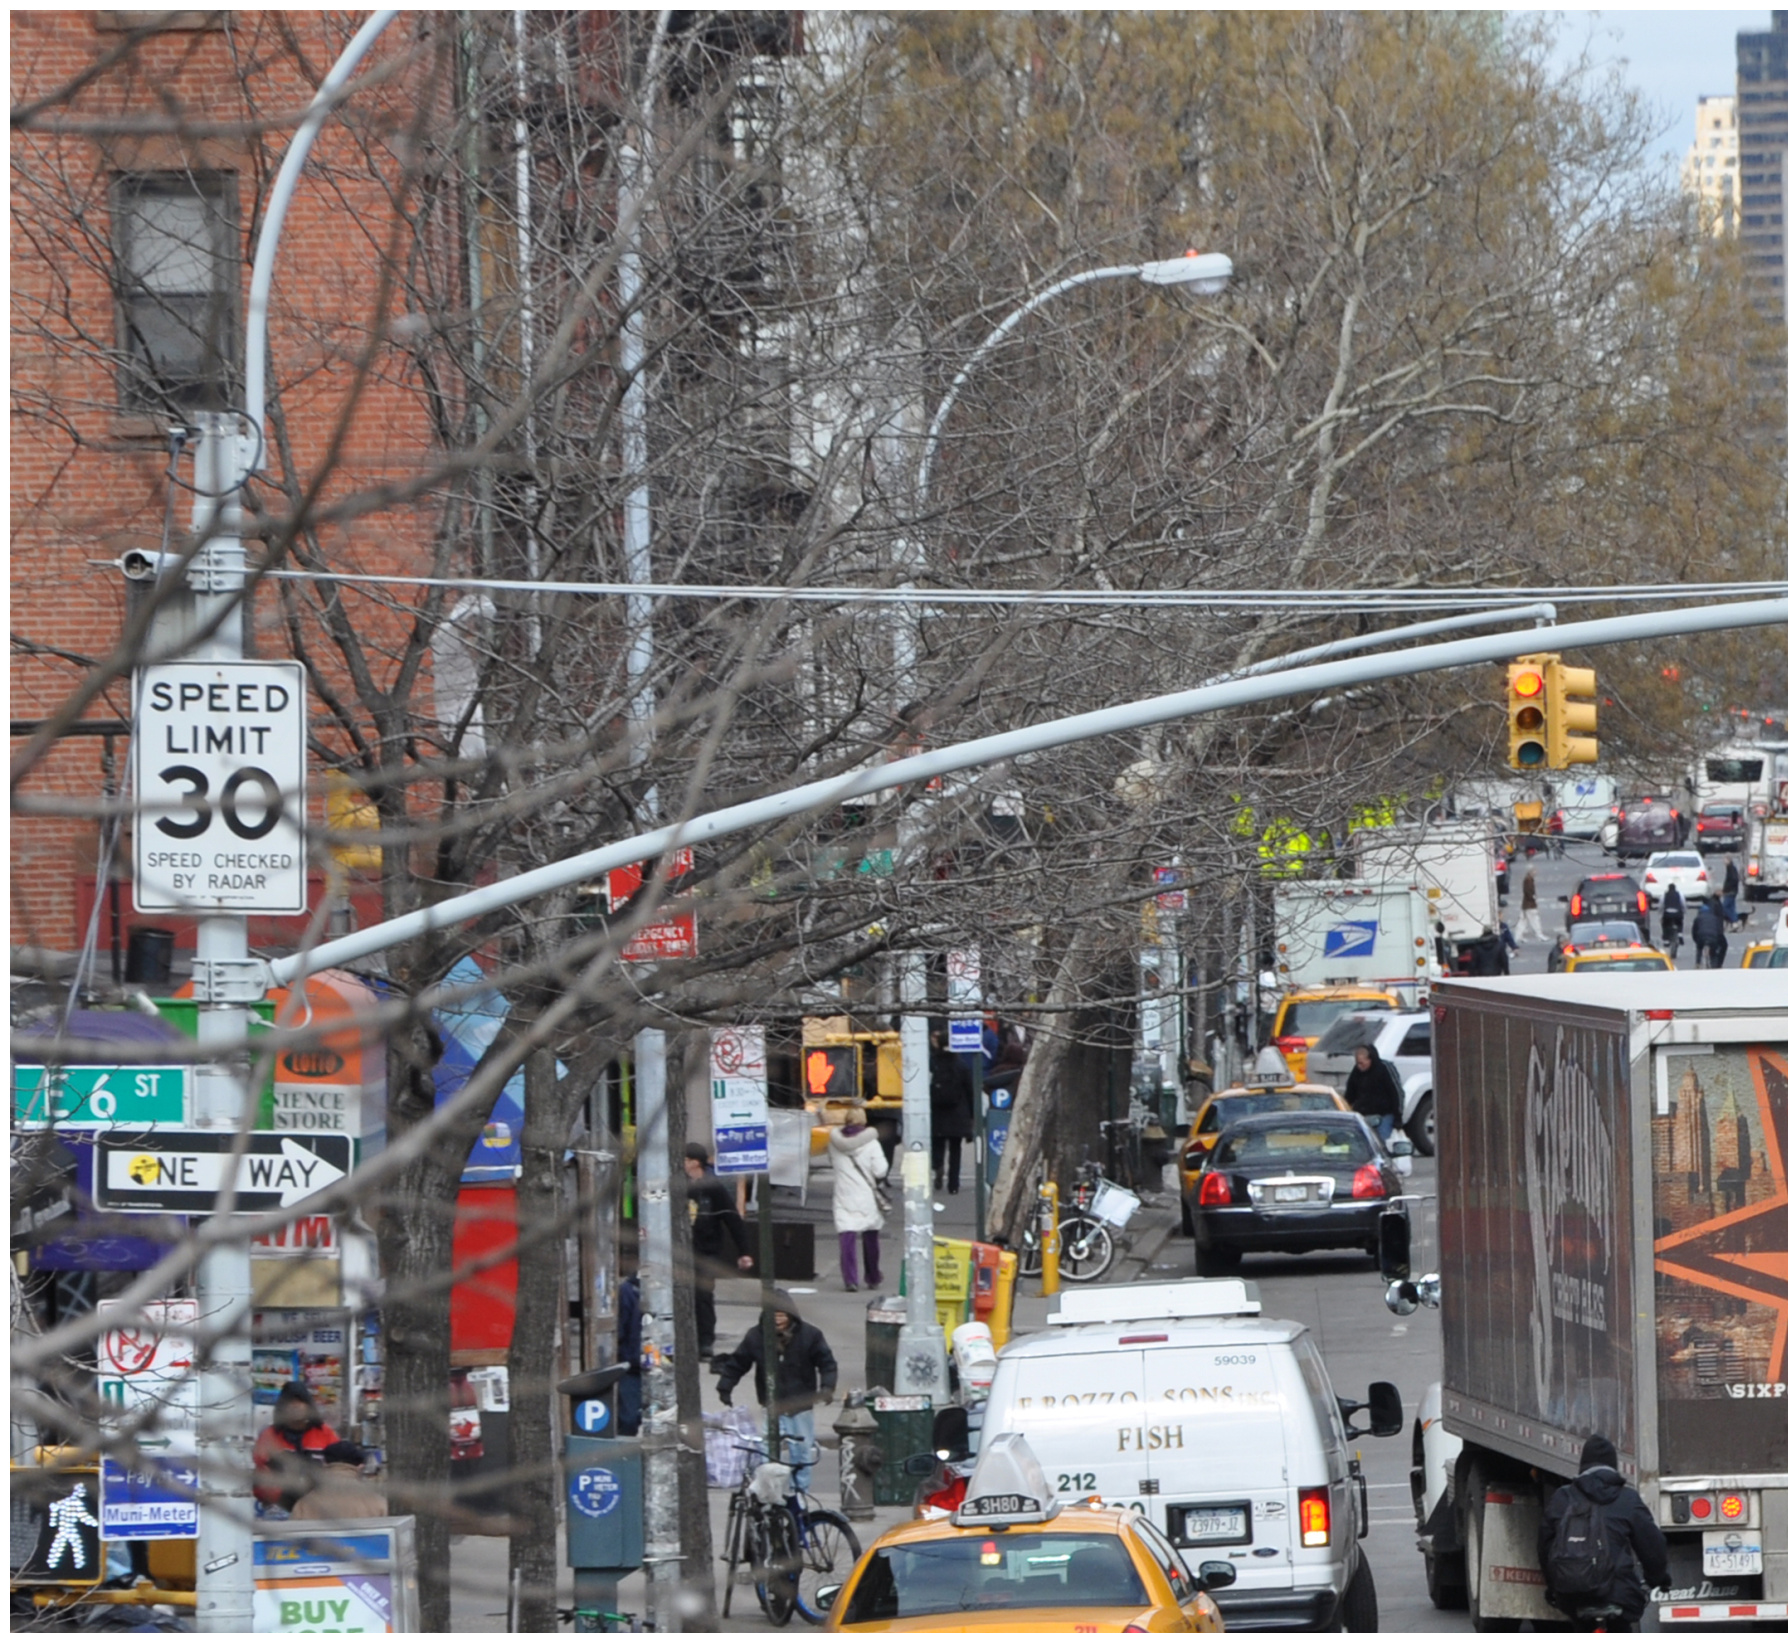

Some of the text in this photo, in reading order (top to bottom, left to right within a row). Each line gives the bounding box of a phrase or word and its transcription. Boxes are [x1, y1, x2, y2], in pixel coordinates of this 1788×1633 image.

[150, 682, 289, 712] SPEED
[166, 725, 271, 754] LIMIT
[154, 765, 284, 840] 30
[147, 852, 292, 869] SPEED CHECKED
[173, 874, 266, 889] BY RADAR
[45, 1072, 161, 1119] E 6 ST
[276, 1113, 345, 1129] STORE
[249, 1159, 319, 1188] WAY
[1214, 1355, 1257, 1366] 59039
[585, 1401, 605, 1431] P
[1117, 1424, 1184, 1452] FISH
[1058, 1473, 1097, 1492] 212
[106, 1507, 194, 1522] Muni-Meter
[981, 1496, 1019, 1514] 3H80
[281, 1599, 350, 1626] BUY
